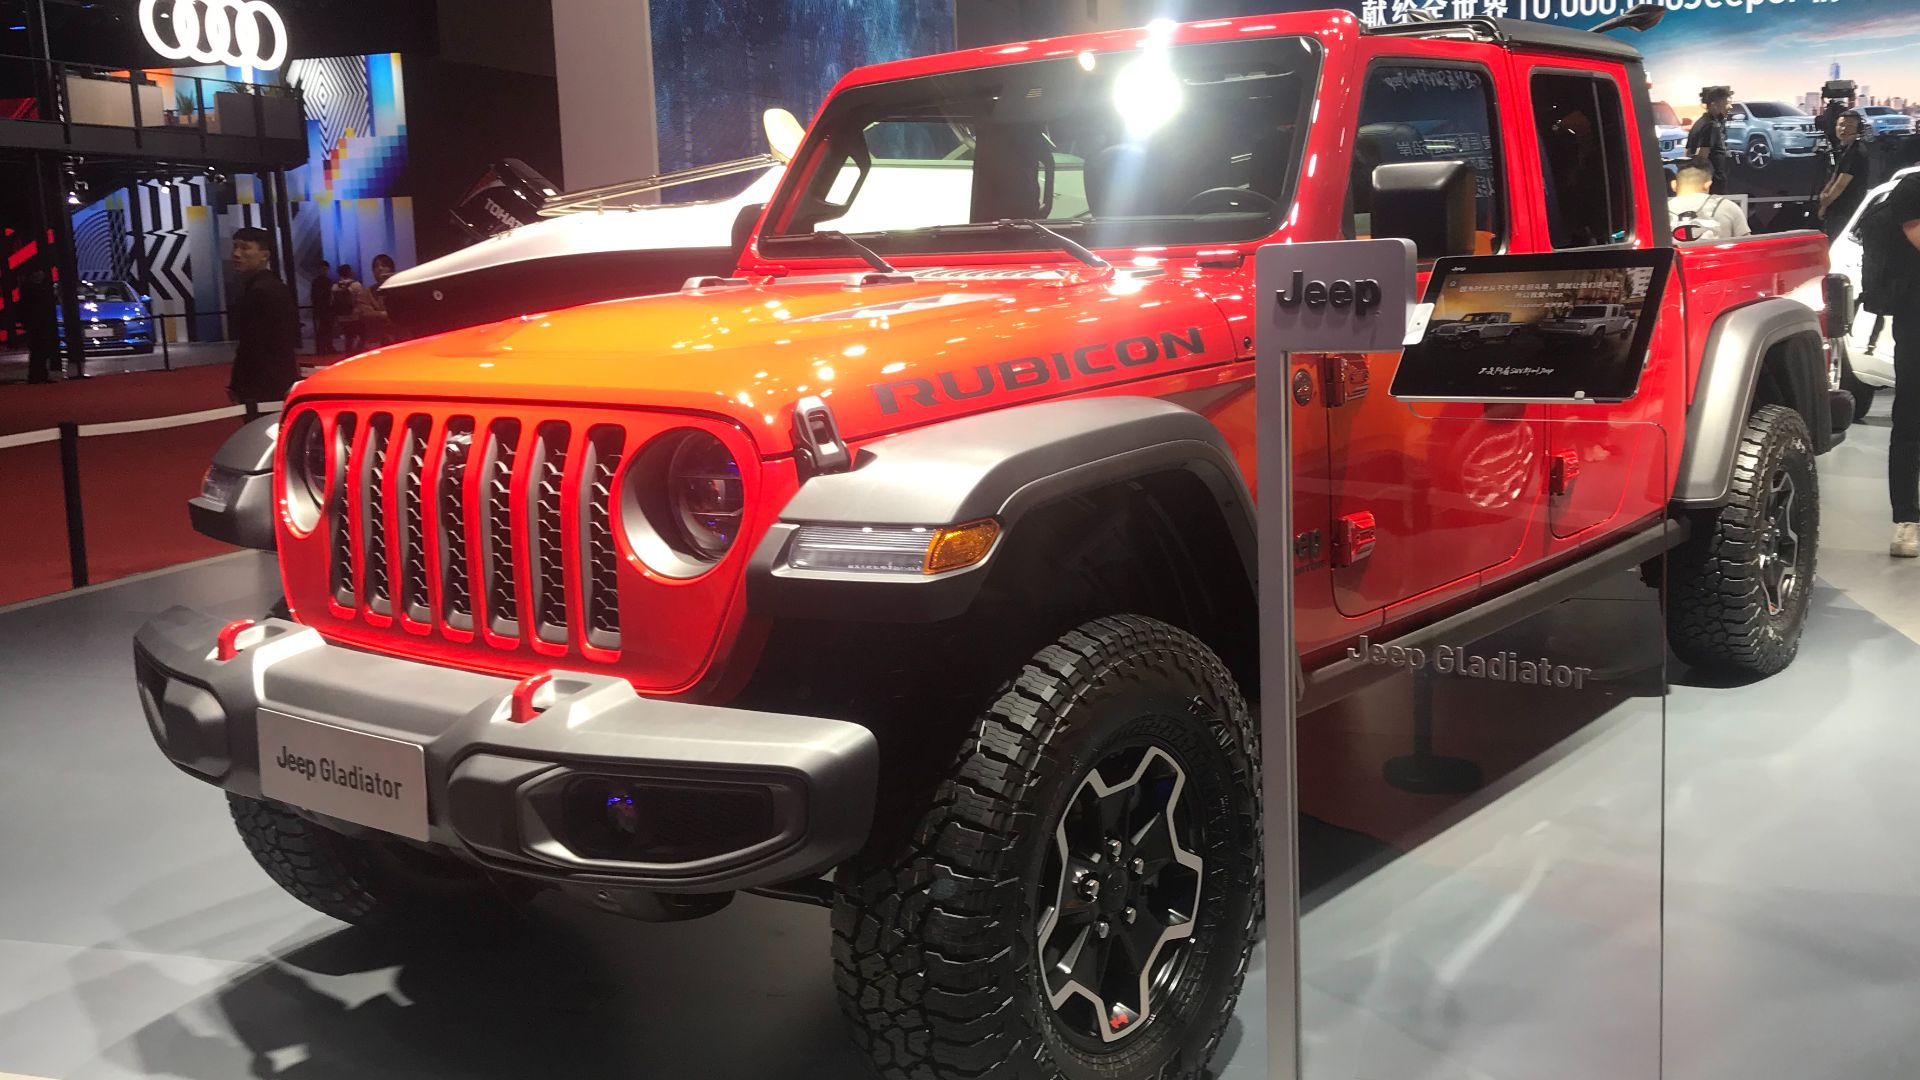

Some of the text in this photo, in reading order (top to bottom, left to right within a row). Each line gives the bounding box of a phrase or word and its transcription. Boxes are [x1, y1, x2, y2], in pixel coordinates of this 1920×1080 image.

[1275, 269, 1382, 317] Jeep
[872, 327, 1206, 416] RUBICON
[1347, 634, 1592, 690] Jeep Gladiator
[276, 745, 403, 800] Jeep Gladiator
